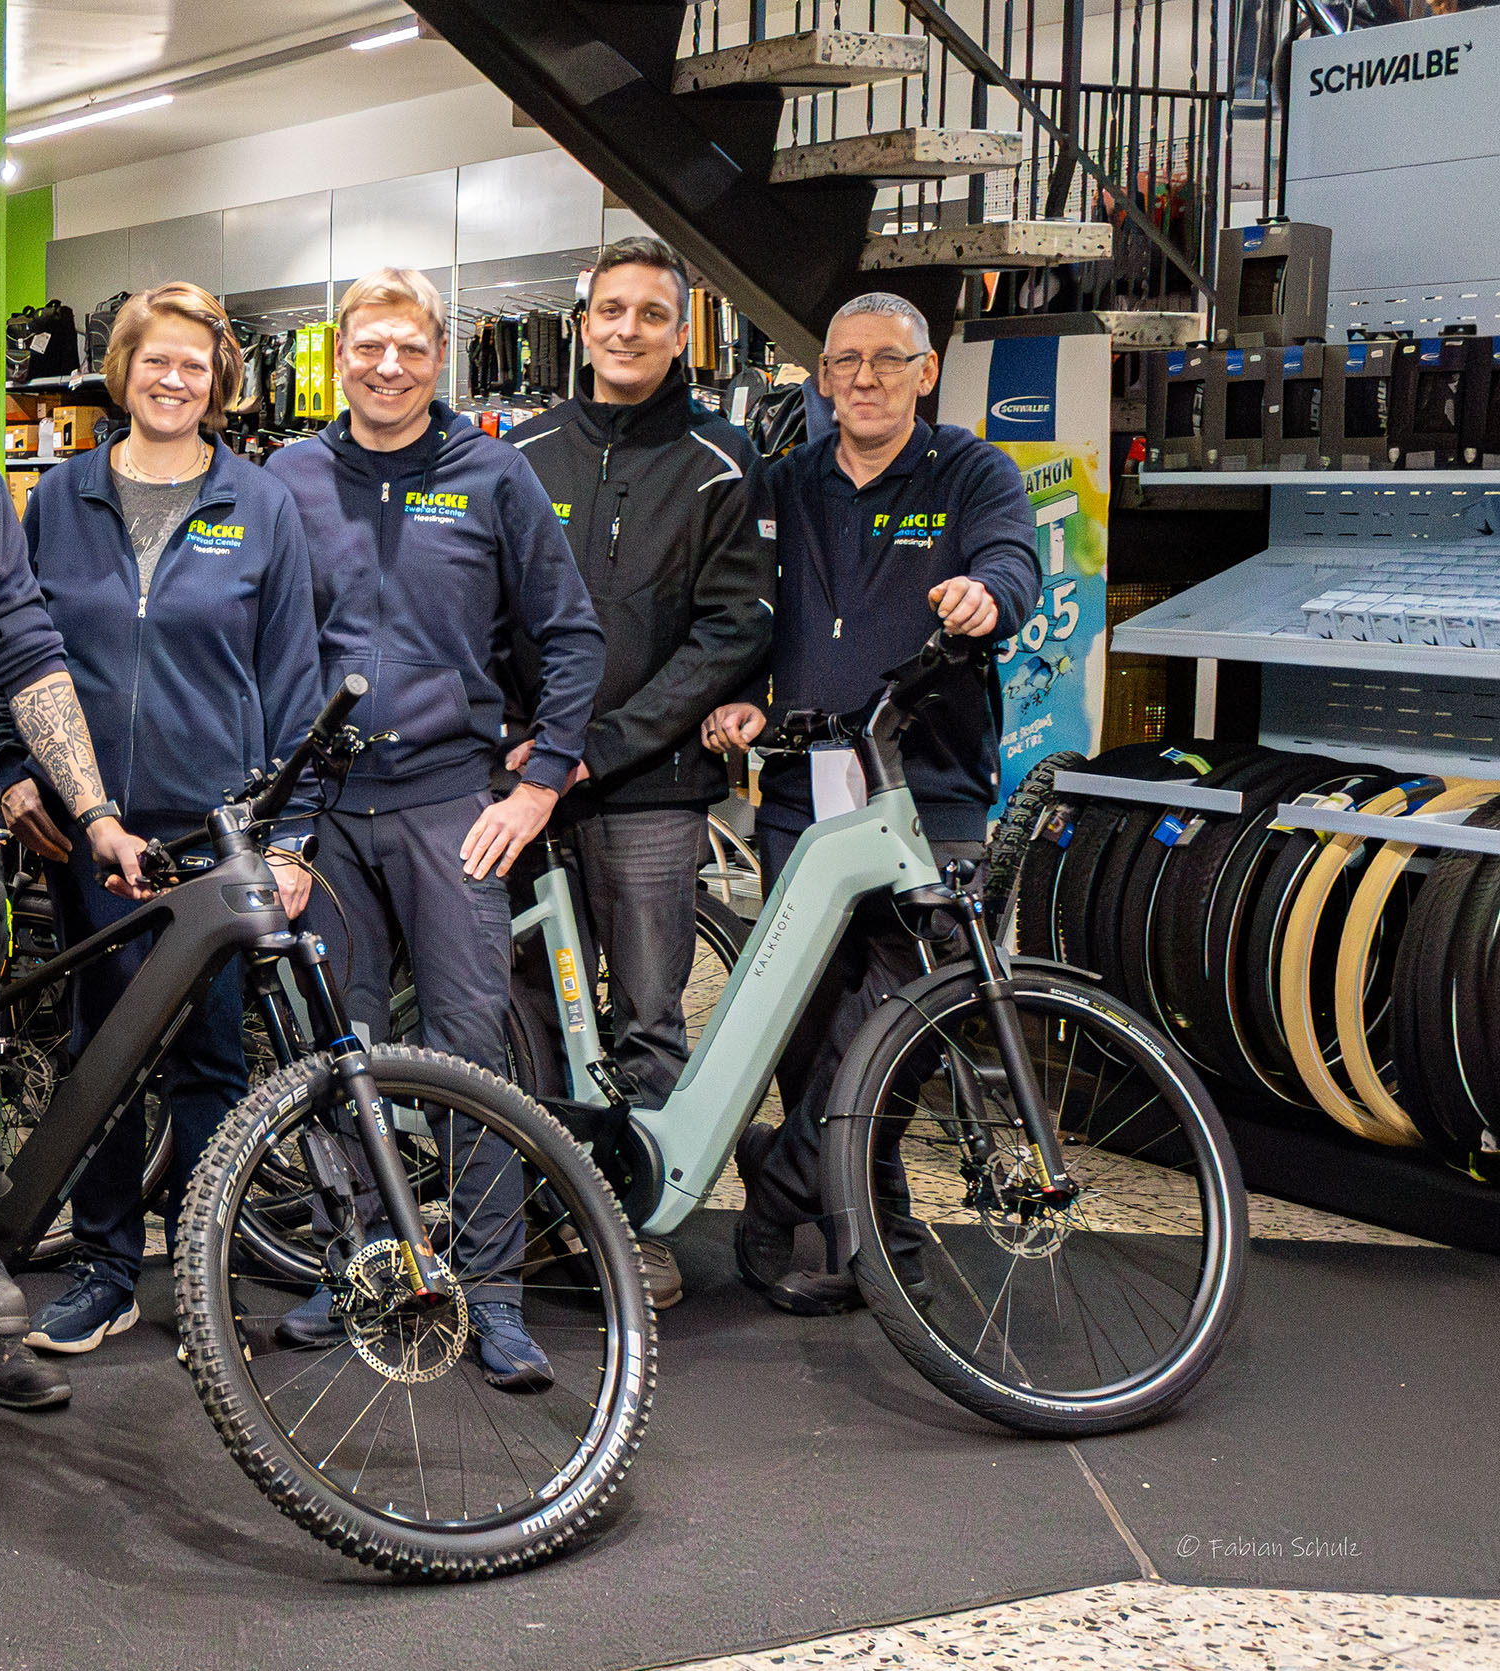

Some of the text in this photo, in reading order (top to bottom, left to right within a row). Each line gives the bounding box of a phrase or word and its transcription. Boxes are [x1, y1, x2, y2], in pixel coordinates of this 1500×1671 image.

[1310, 46, 1460, 97] SCHWALBE
[1000, 403, 1050, 414] SCHWALBE
[1025, 458, 1073, 494] ATHON
[215, 538, 242, 548] Center
[753, 902, 796, 977] KALKHOFF
[216, 1083, 310, 1229] SCHWALBE
[521, 1395, 637, 1536] MAGIC MARY
